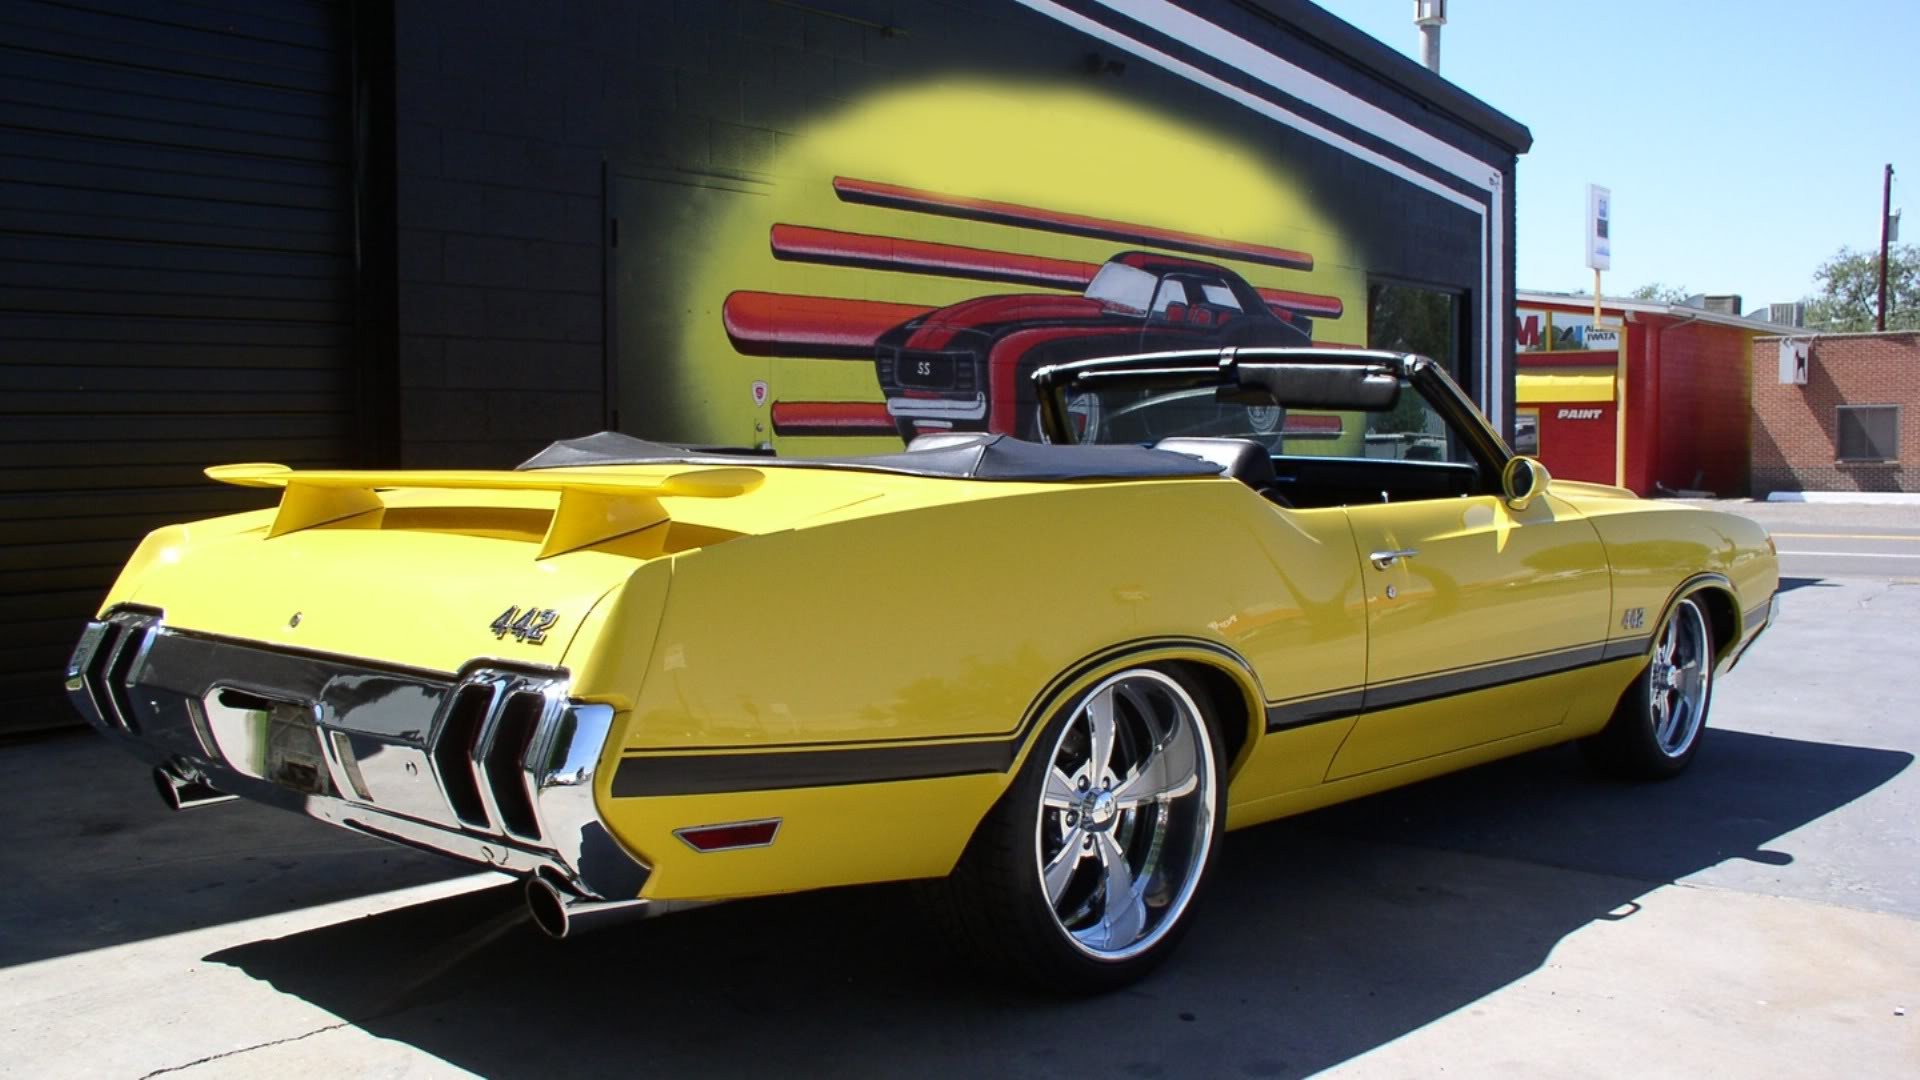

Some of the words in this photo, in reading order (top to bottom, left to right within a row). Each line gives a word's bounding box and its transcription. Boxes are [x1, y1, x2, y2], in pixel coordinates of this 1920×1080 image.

[917, 361, 930, 375] SS
[1557, 409, 1602, 419] PAINT
[489, 604, 560, 646] 442
